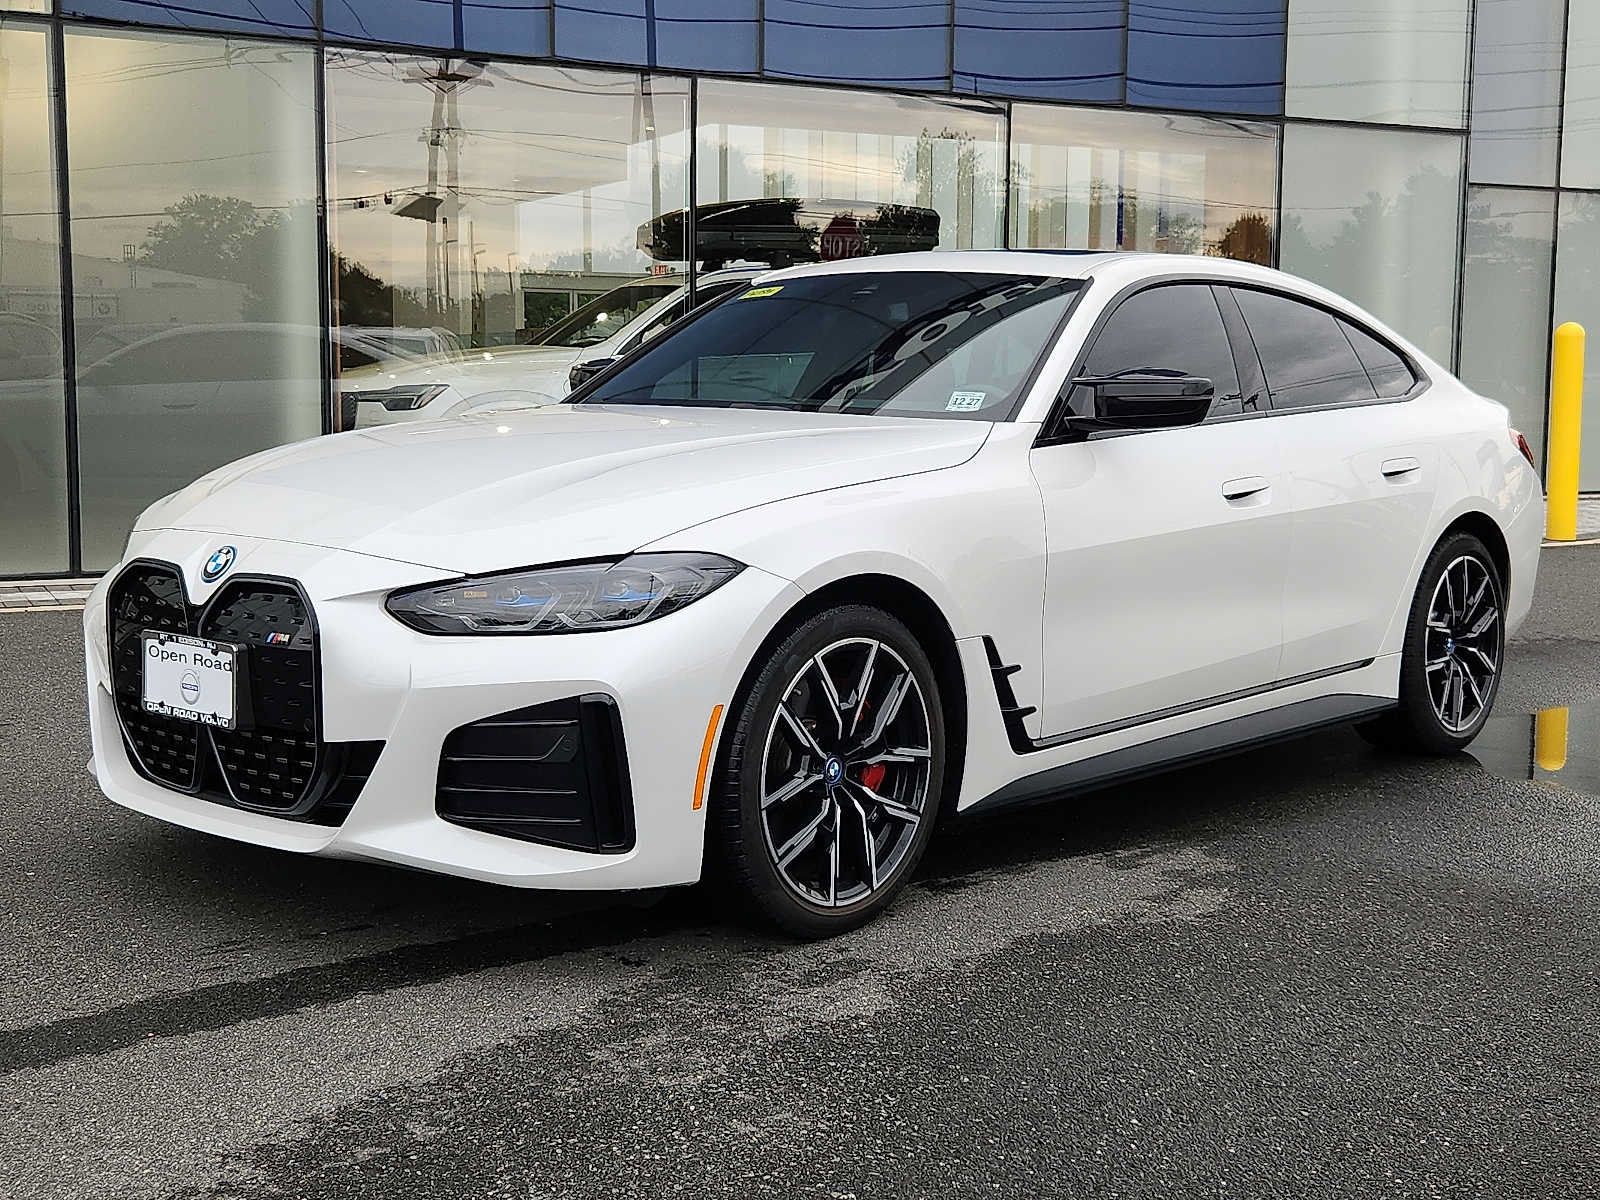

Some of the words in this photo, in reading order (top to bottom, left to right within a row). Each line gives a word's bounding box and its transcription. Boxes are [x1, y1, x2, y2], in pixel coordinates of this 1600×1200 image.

[952, 397, 966, 405] 12
[966, 398, 981, 407] 27
[206, 641, 217, 650] NJ
[148, 644, 188, 663] Open
[193, 653, 233, 673] Road
[146, 702, 172, 715] OPEN
[172, 708, 199, 721] ROAD
[199, 713, 230, 728] VOLVO
